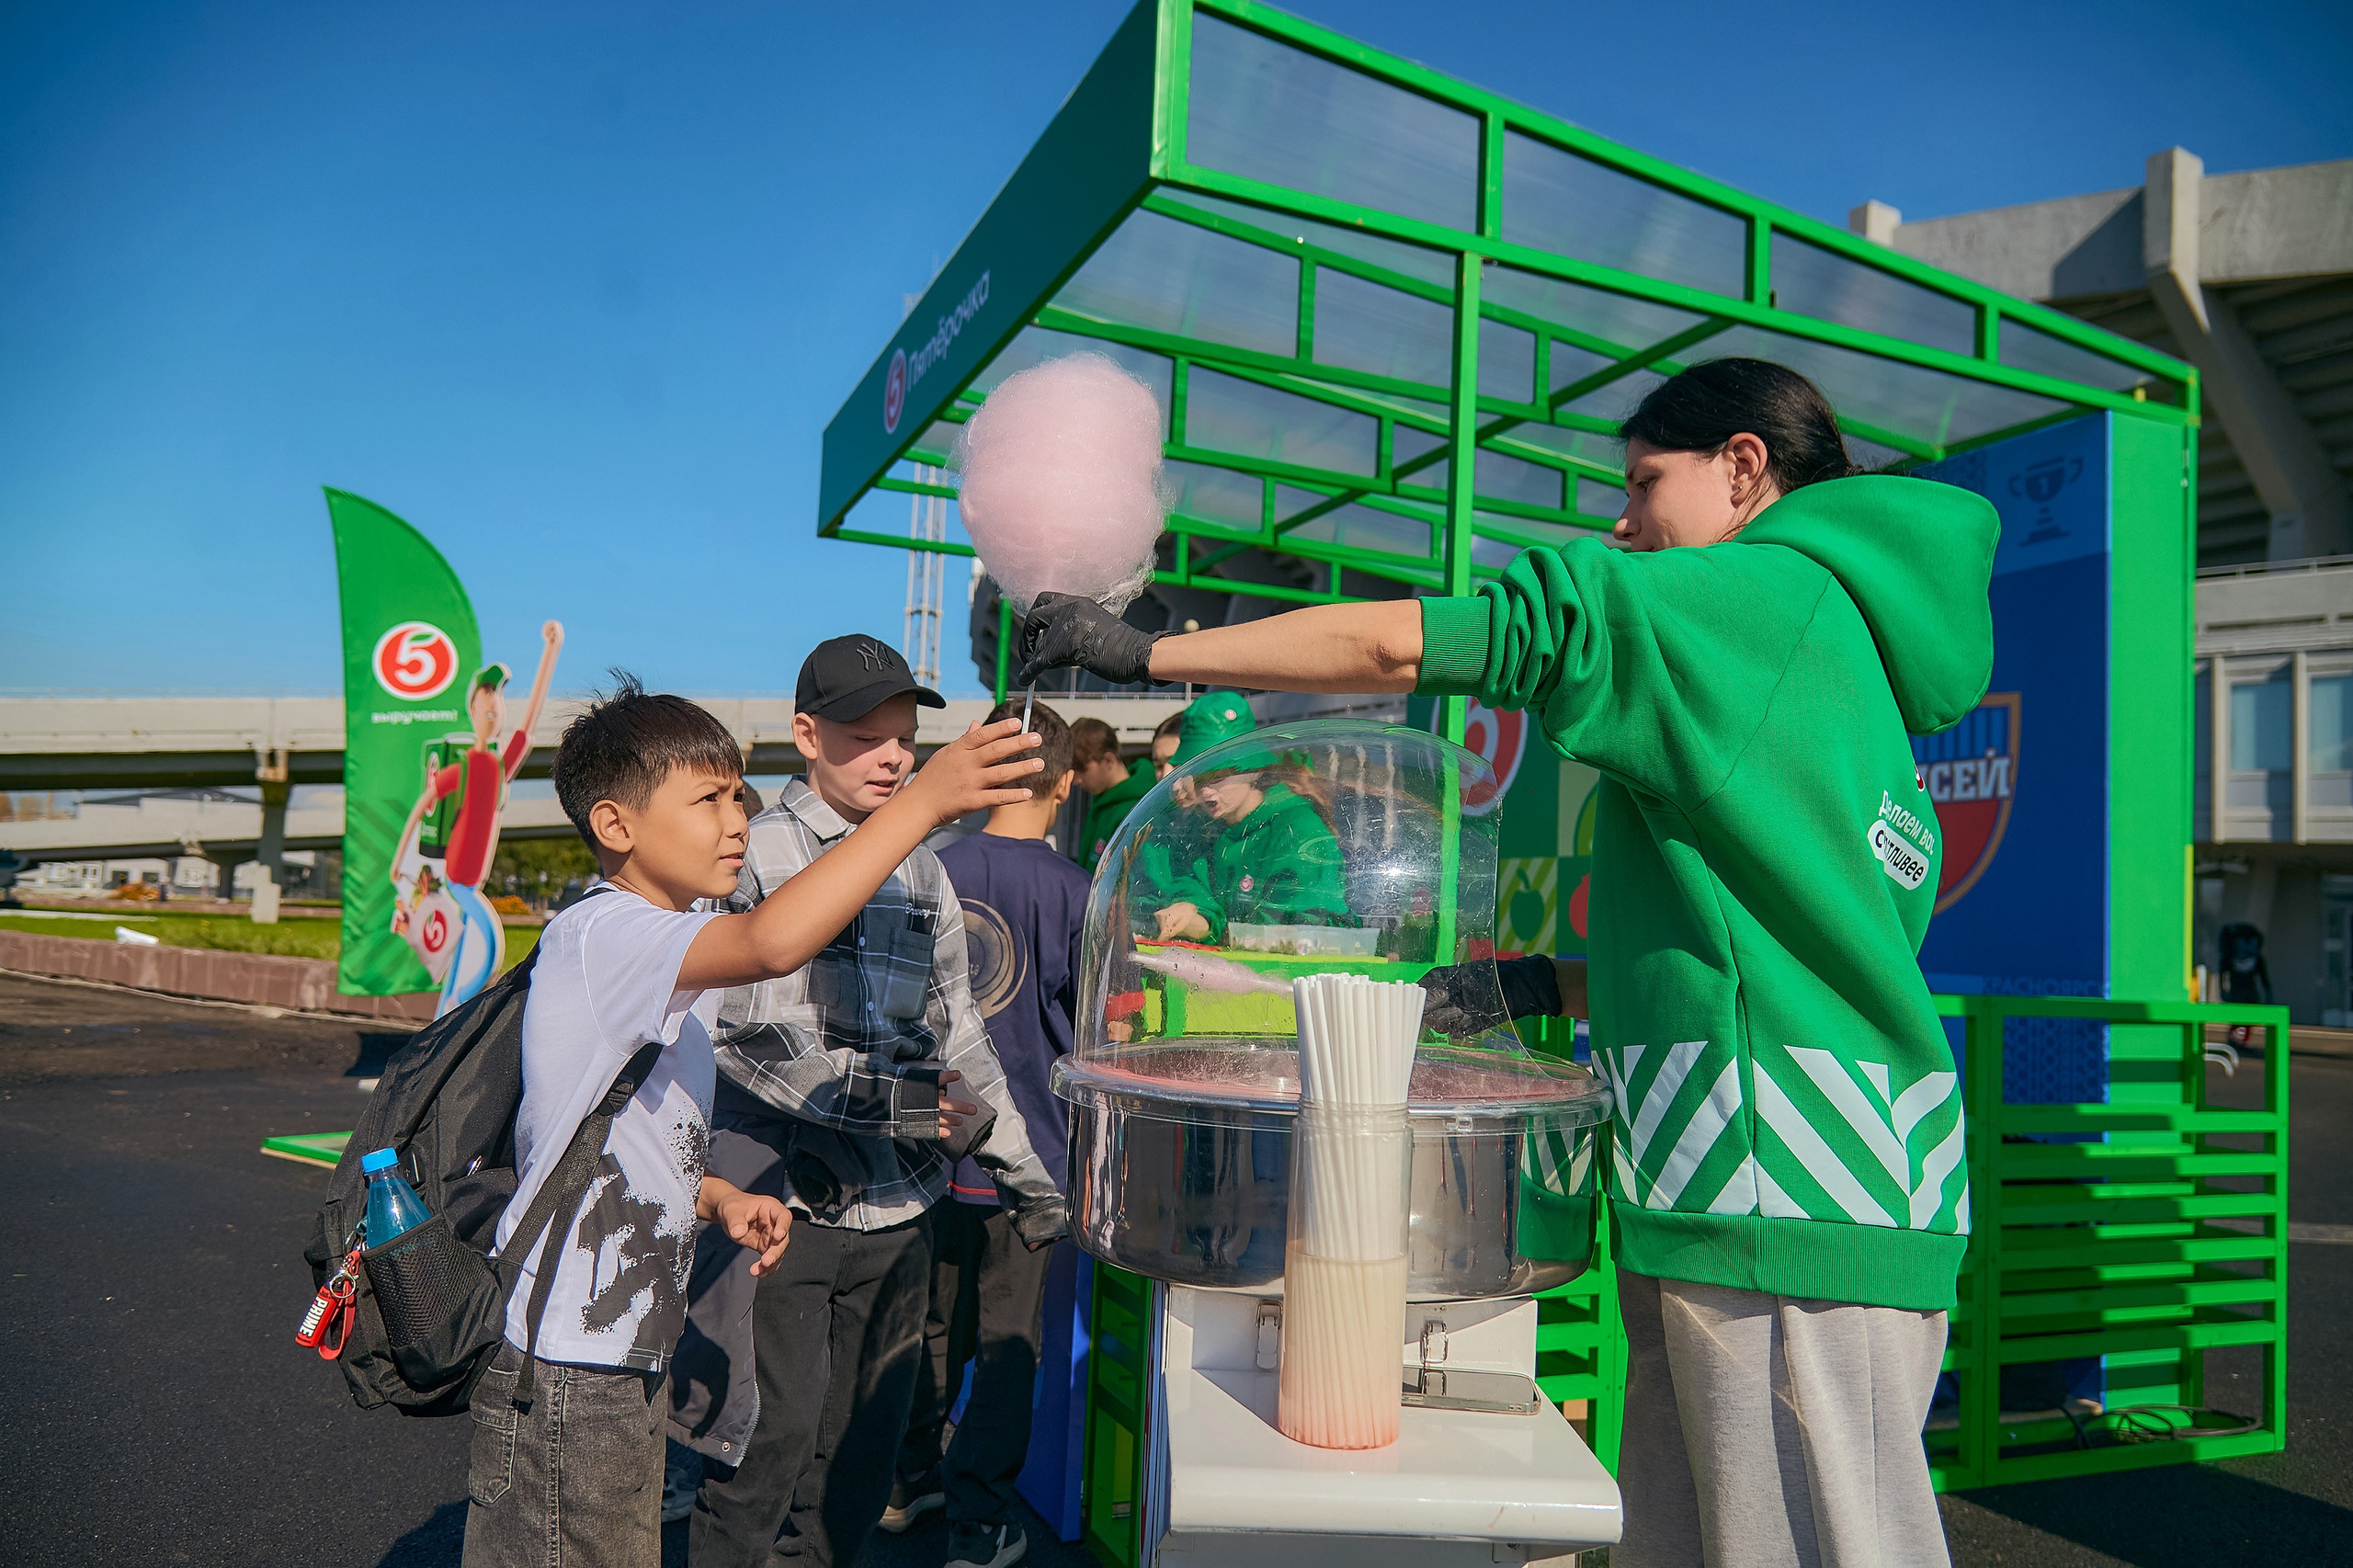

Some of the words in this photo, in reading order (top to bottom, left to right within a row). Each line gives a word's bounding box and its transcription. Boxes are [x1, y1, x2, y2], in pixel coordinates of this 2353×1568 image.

[394, 629, 439, 687] 5
[1878, 789, 1924, 840] Делаем
[299, 1296, 329, 1337] PRIME
